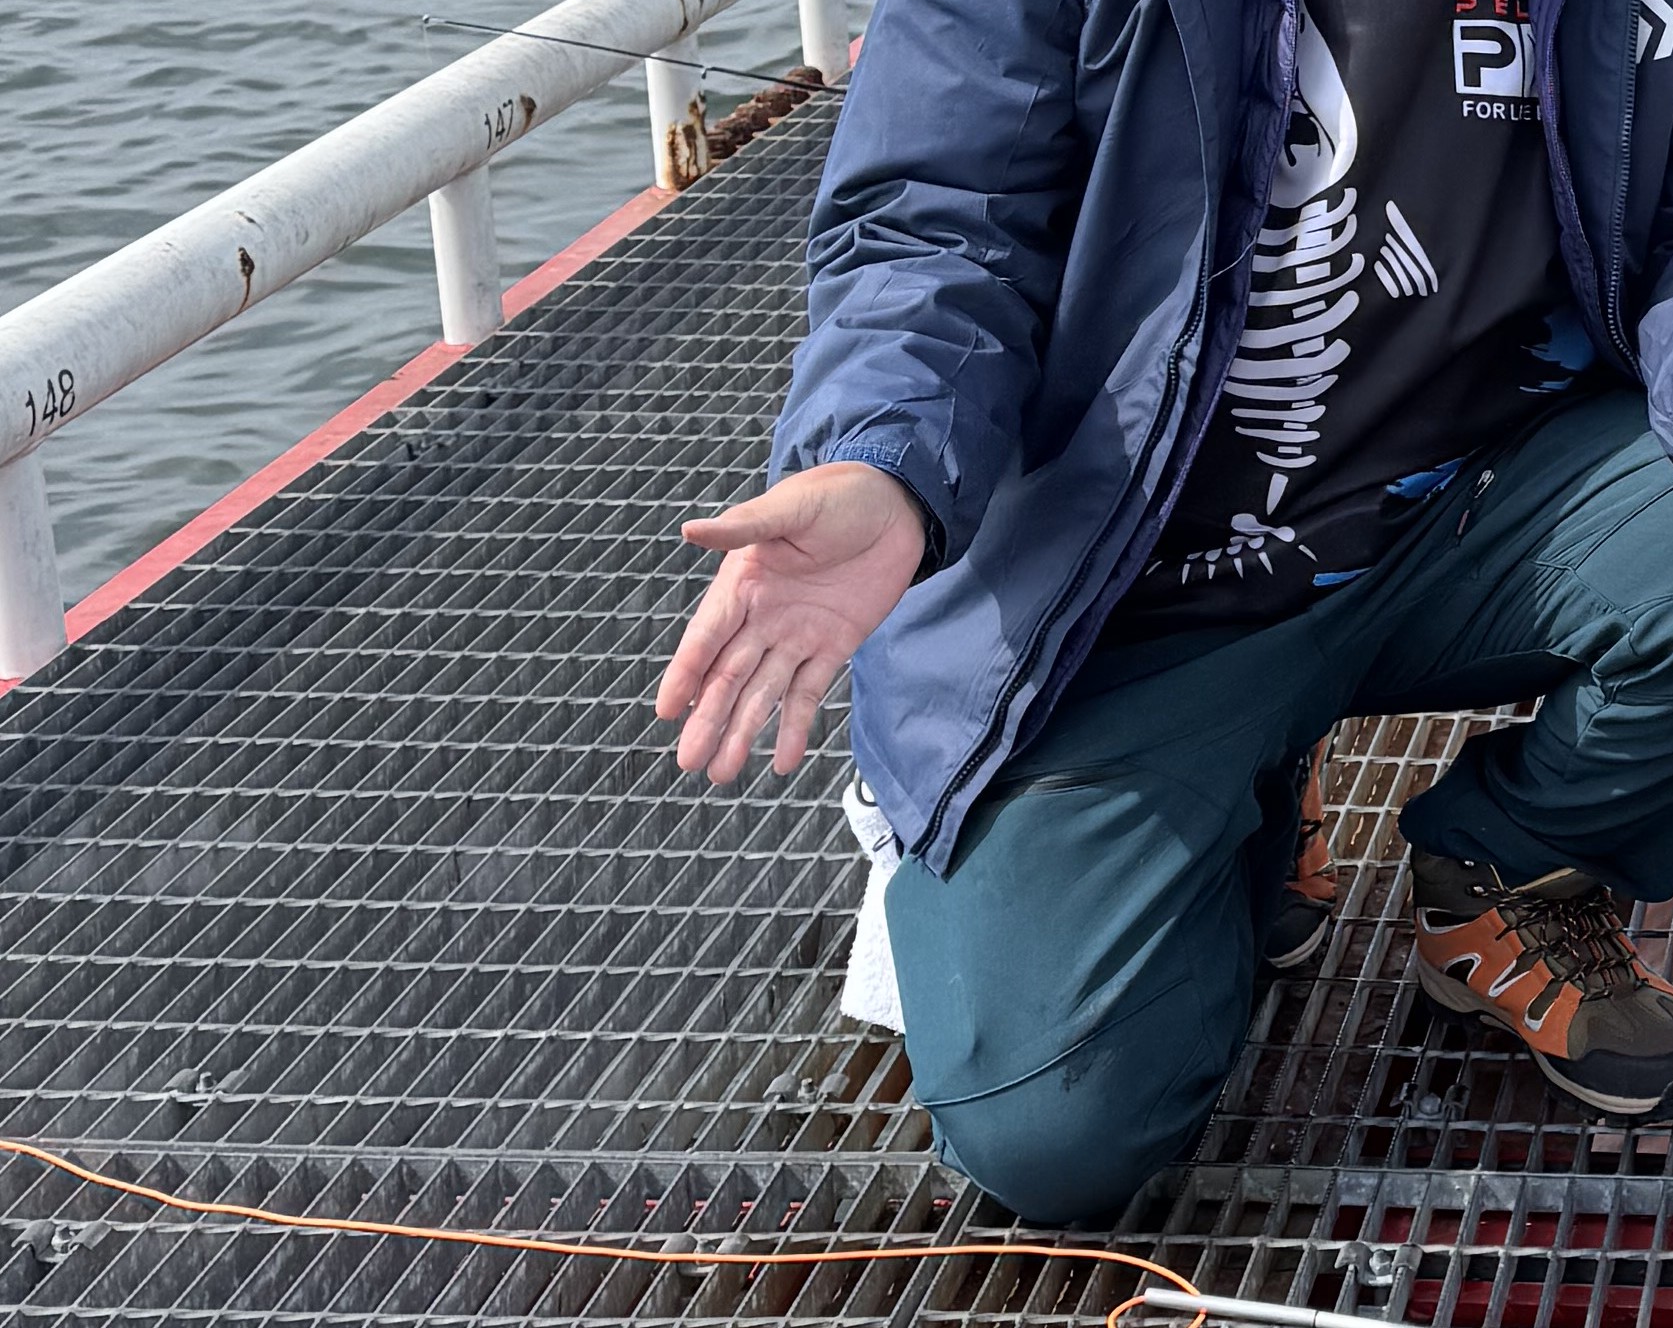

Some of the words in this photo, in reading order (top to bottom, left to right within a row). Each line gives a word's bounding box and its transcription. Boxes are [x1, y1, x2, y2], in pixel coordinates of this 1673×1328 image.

[484, 98, 514, 151] 147
[1462, 100, 1506, 120] FOR
[25, 368, 76, 438] 148
